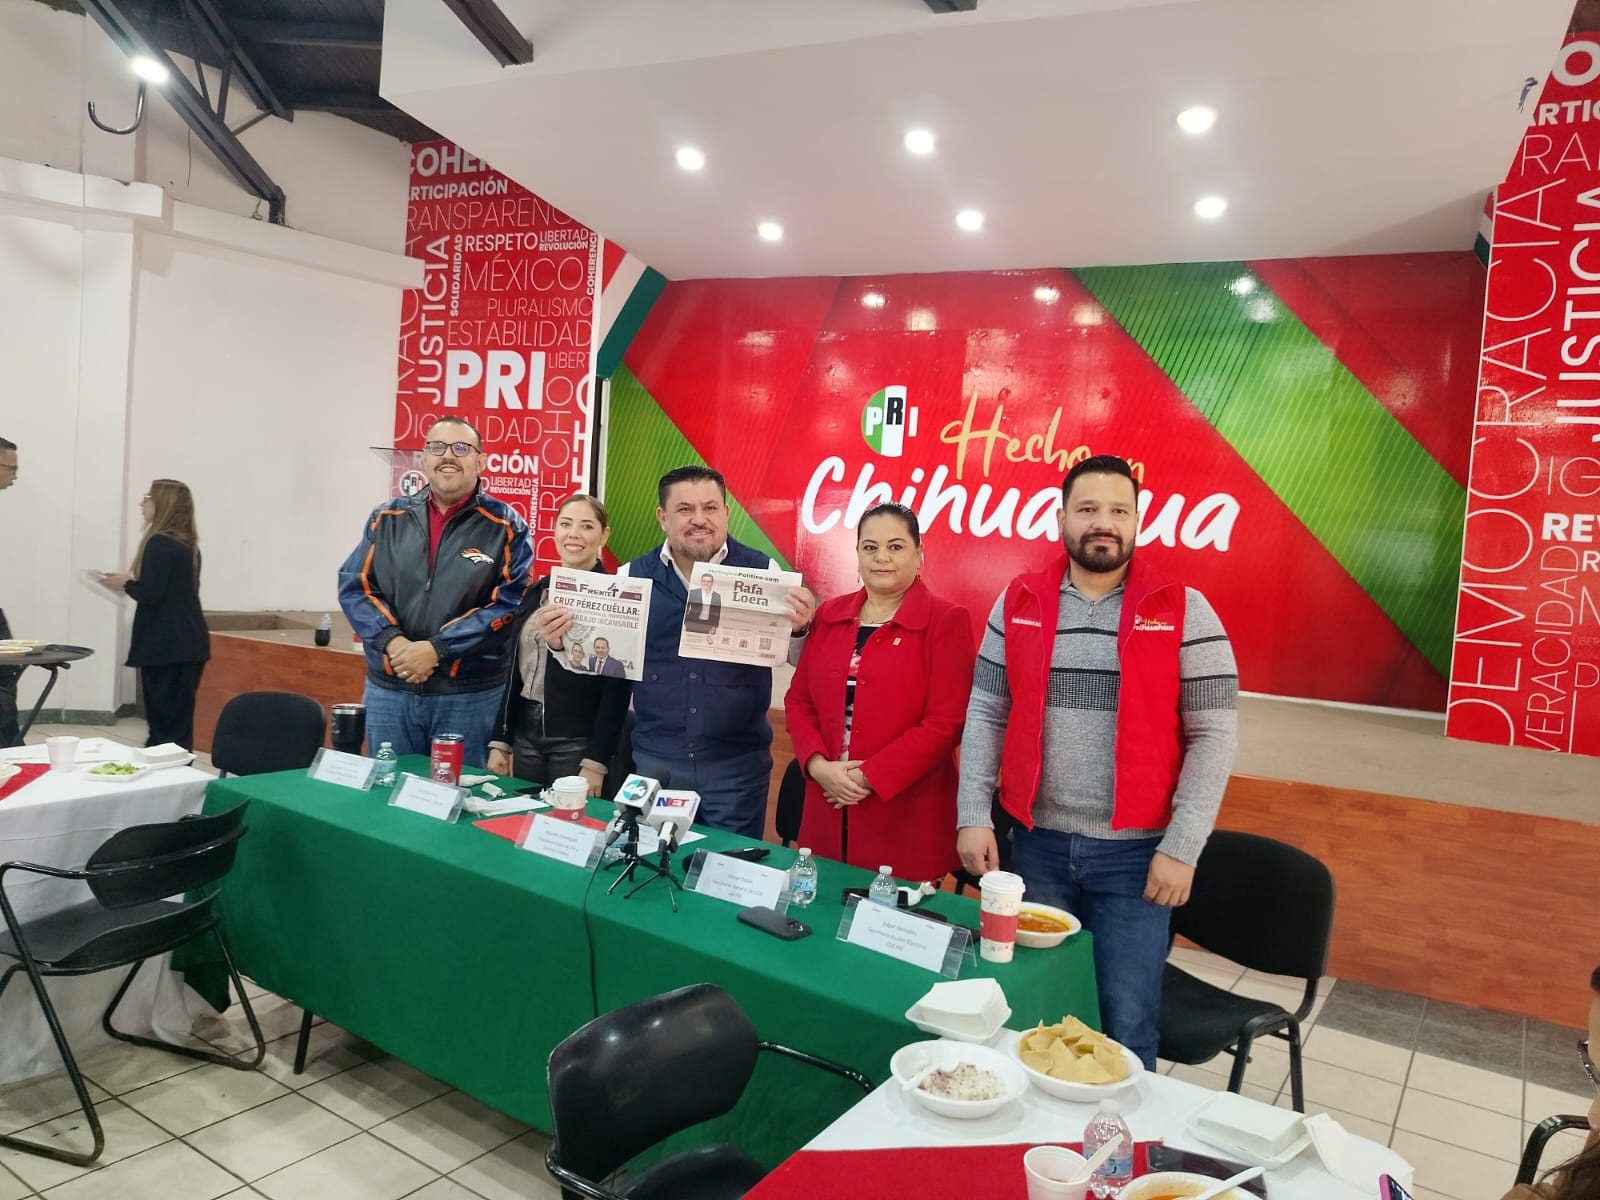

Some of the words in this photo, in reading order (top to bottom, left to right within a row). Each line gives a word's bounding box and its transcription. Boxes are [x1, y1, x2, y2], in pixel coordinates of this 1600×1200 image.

[464, 231, 538, 252] RESPETO
[539, 239, 588, 252] REVOLUCIÓN
[540, 229, 589, 243] LIBERTAD
[450, 234, 463, 317] SOLIDARIDAD
[463, 253, 584, 292] MÉXICO
[487, 296, 593, 318] PLURALISMO
[417, 235, 451, 405] JUSTICIA
[447, 319, 593, 348] ESTABILIDAD
[444, 350, 546, 410] PRI
[865, 396, 918, 436] PRI
[940, 392, 1092, 480] Hecho
[535, 375, 575, 563] DERECHO
[490, 476, 532, 490] LIBERTAD
[490, 486, 531, 497] REVOLUCIÓN
[529, 477, 539, 537] COHERENCIA
[801, 455, 1241, 552] Chihuaua
[733, 591, 769, 607] Loera
[734, 580, 763, 596] Rafa
[554, 595, 575, 607] CRUZ
[576, 599, 601, 611] PÉREZ
[602, 603, 641, 616] CUÉLLAR:
[598, 618, 640, 630] INCANSABLE
[1525, 545, 1579, 752] VERACIDAD
[656, 797, 690, 808] NET
